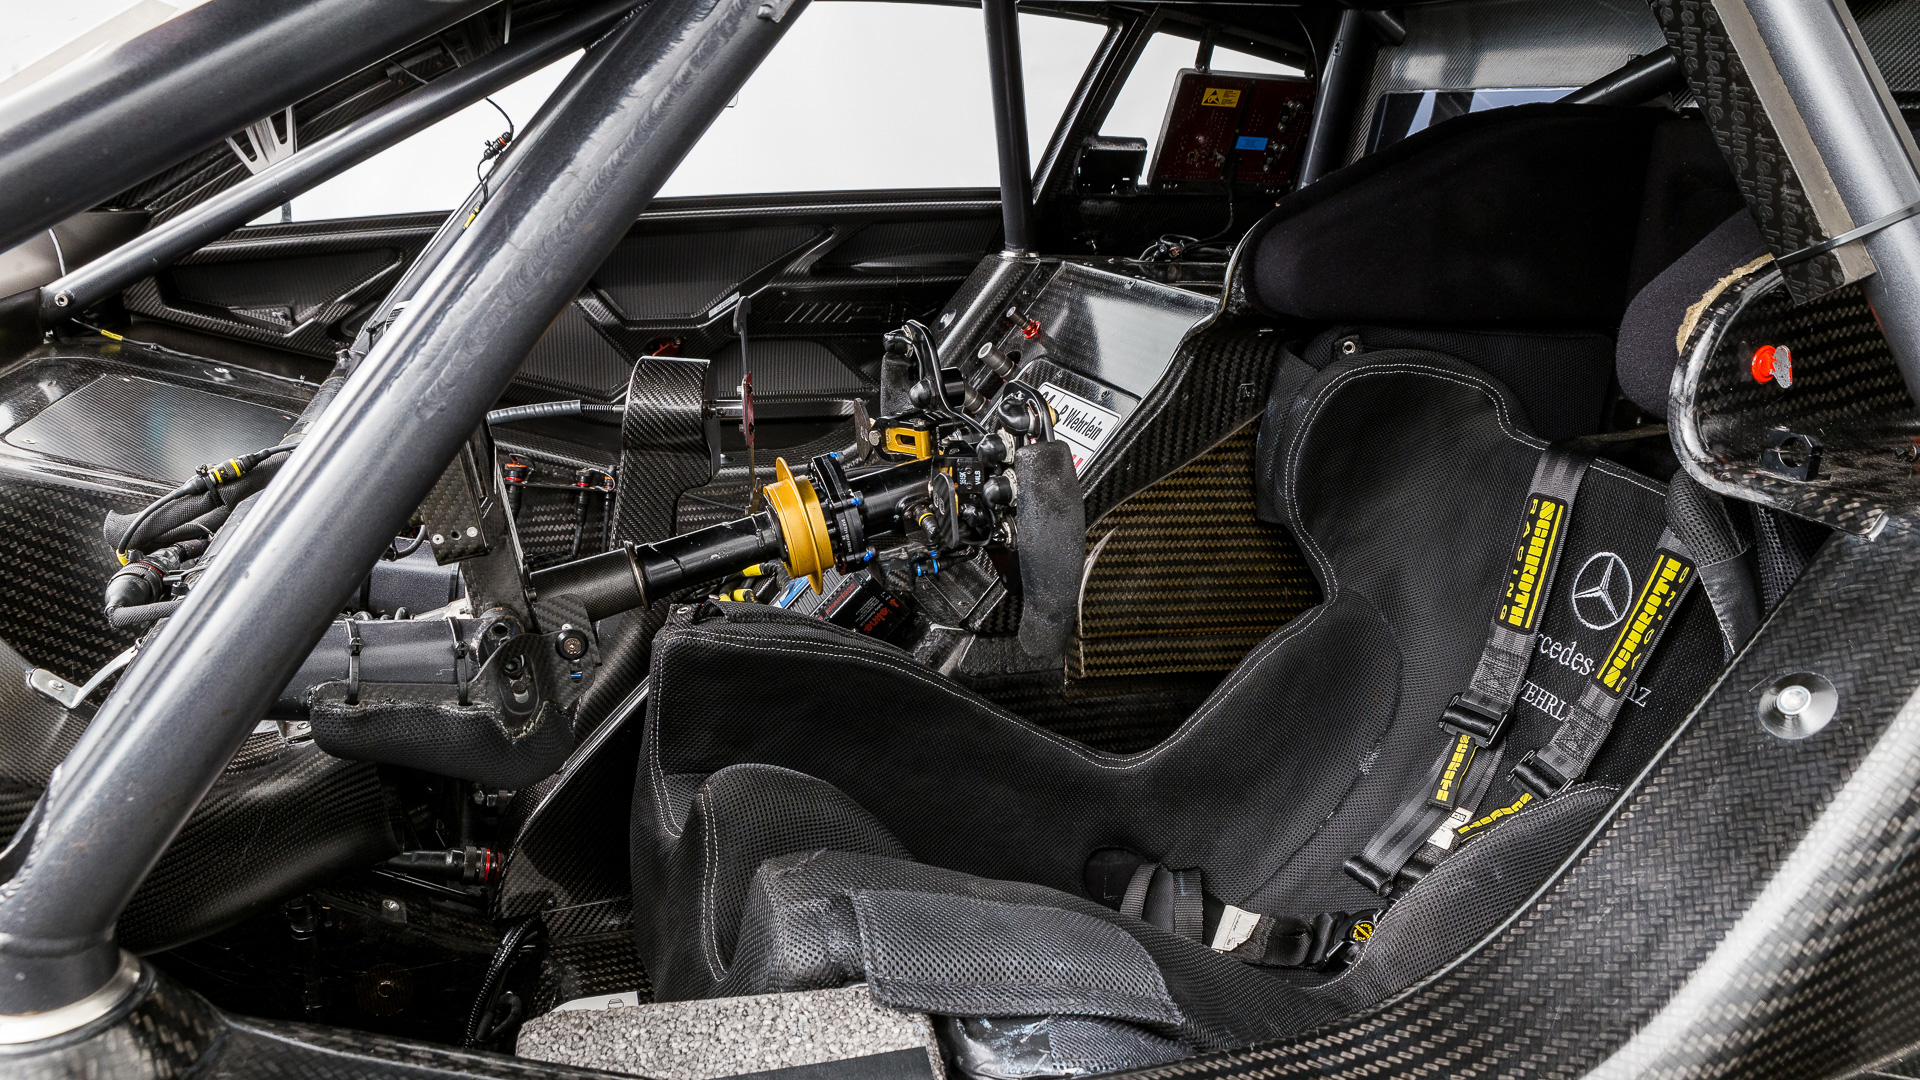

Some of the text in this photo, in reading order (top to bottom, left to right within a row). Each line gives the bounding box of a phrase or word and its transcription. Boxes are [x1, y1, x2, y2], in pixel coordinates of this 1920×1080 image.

[1704, 31, 1727, 123] lifeline
[1729, 82, 1752, 175] lifeline
[1754, 133, 1778, 222] lifeline
[1779, 184, 1803, 274] lifelin
[1062, 407, 1103, 441] Wehrlein
[1500, 498, 1539, 620] RACING
[1508, 501, 1556, 626] SCHROTH
[863, 598, 899, 633] lieline
[1603, 557, 1682, 688] SCHROTH
[1615, 566, 1690, 693] RACING
[1436, 734, 1471, 802] SCHROTH
[1458, 792, 1533, 834] SCHROTH
